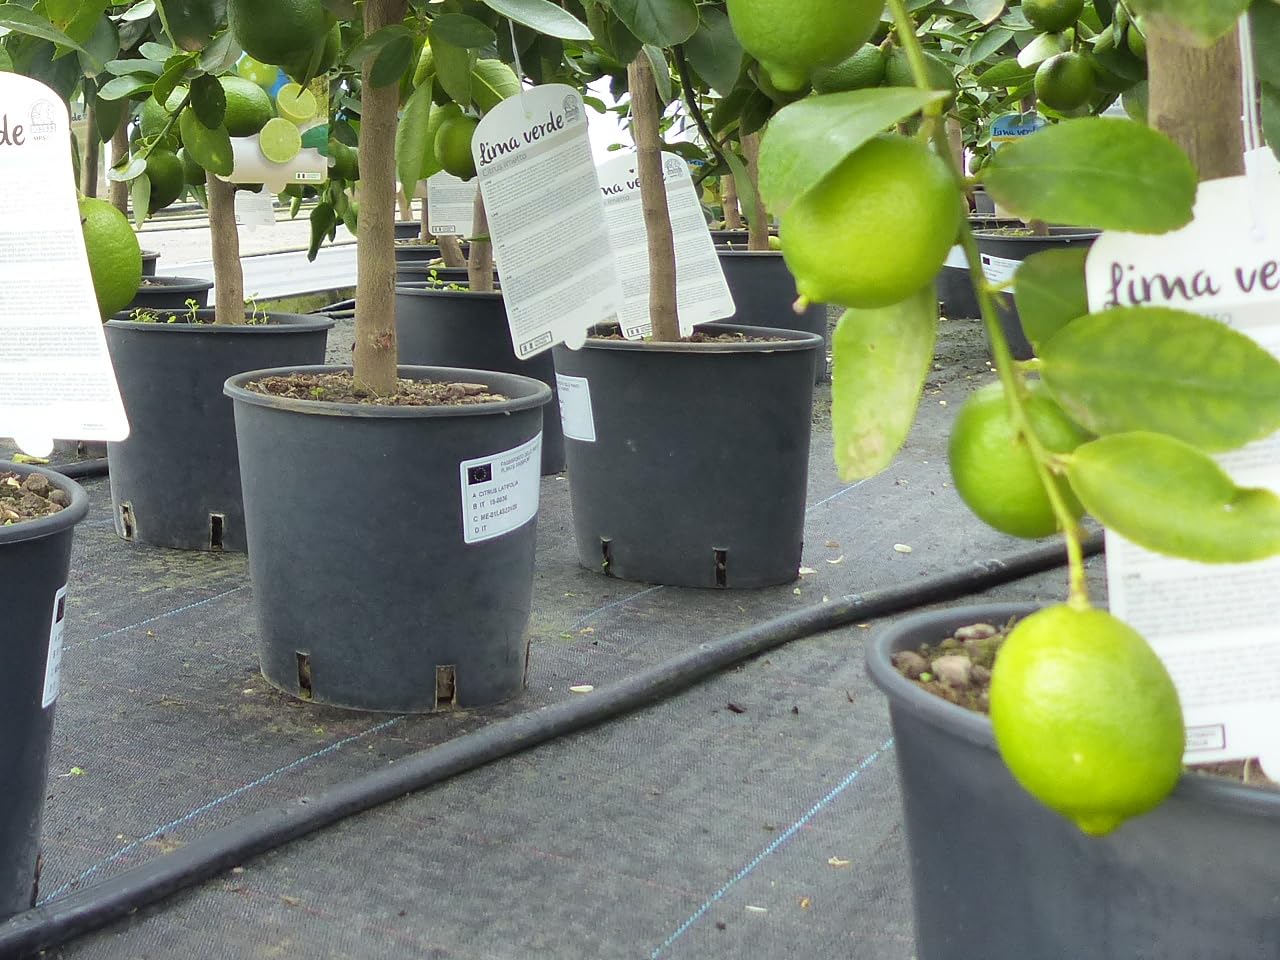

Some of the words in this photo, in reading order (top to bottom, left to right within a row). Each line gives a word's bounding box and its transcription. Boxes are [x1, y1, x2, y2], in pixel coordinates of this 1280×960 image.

[479, 136, 521, 167] Lima
[523, 110, 564, 144] verde
[1104, 261, 1221, 308] Lima
[472, 502, 478, 510] B
[478, 487, 498, 498] CITRUS
